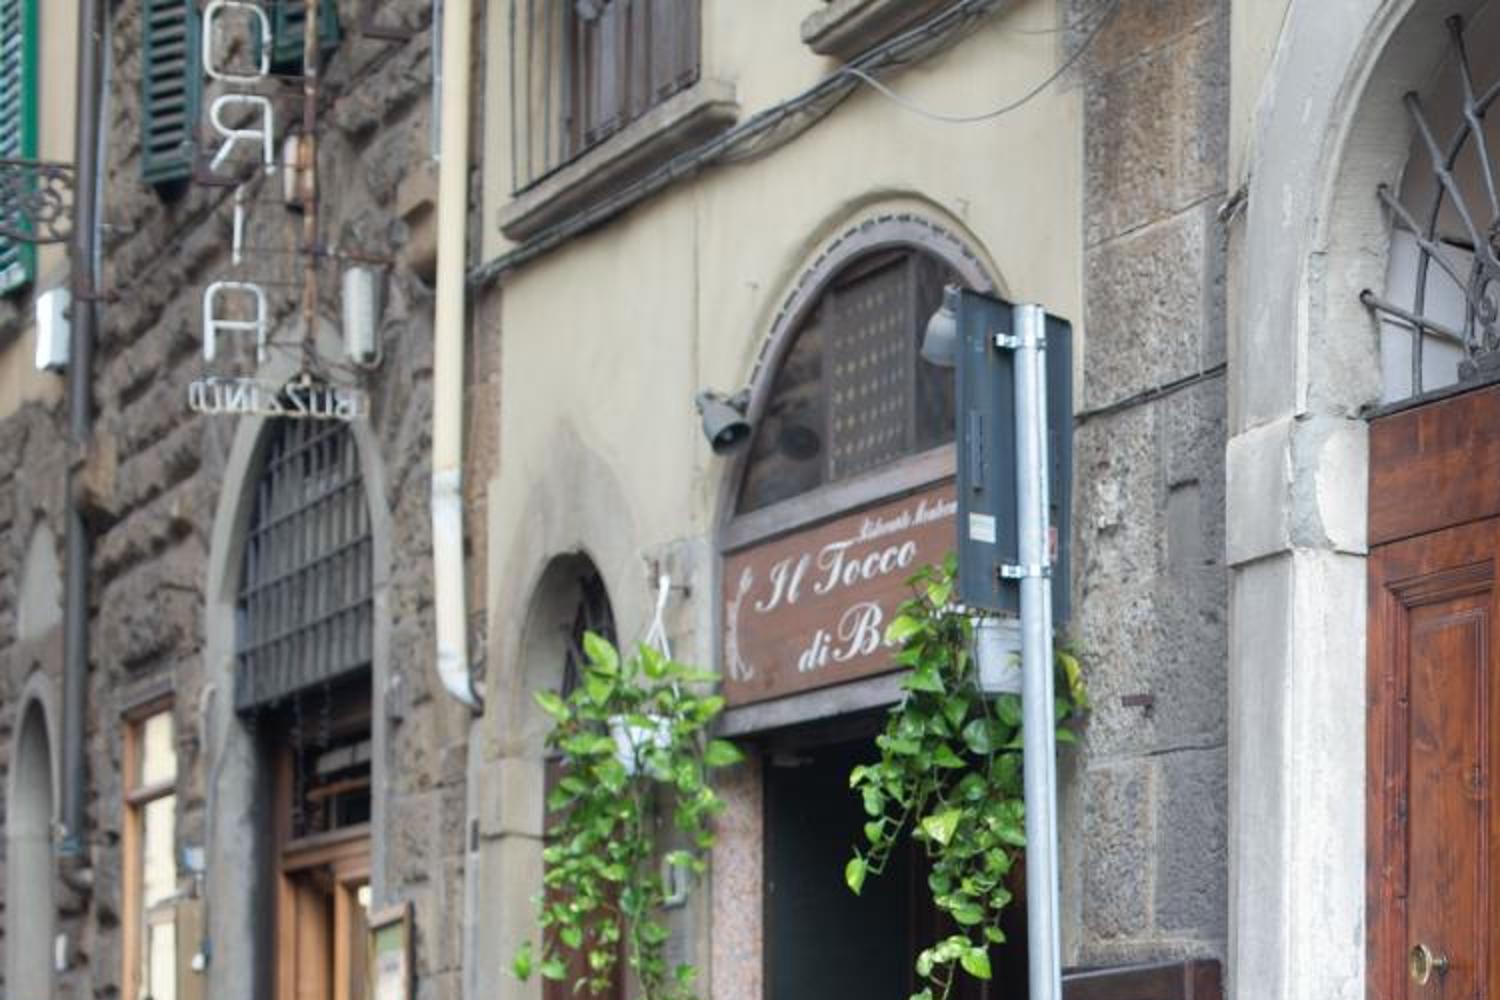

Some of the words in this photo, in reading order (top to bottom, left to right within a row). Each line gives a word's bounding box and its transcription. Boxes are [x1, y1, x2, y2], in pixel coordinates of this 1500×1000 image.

[755, 556, 811, 613] Il
[814, 540, 917, 595] Tocco
[798, 628, 833, 672] di
